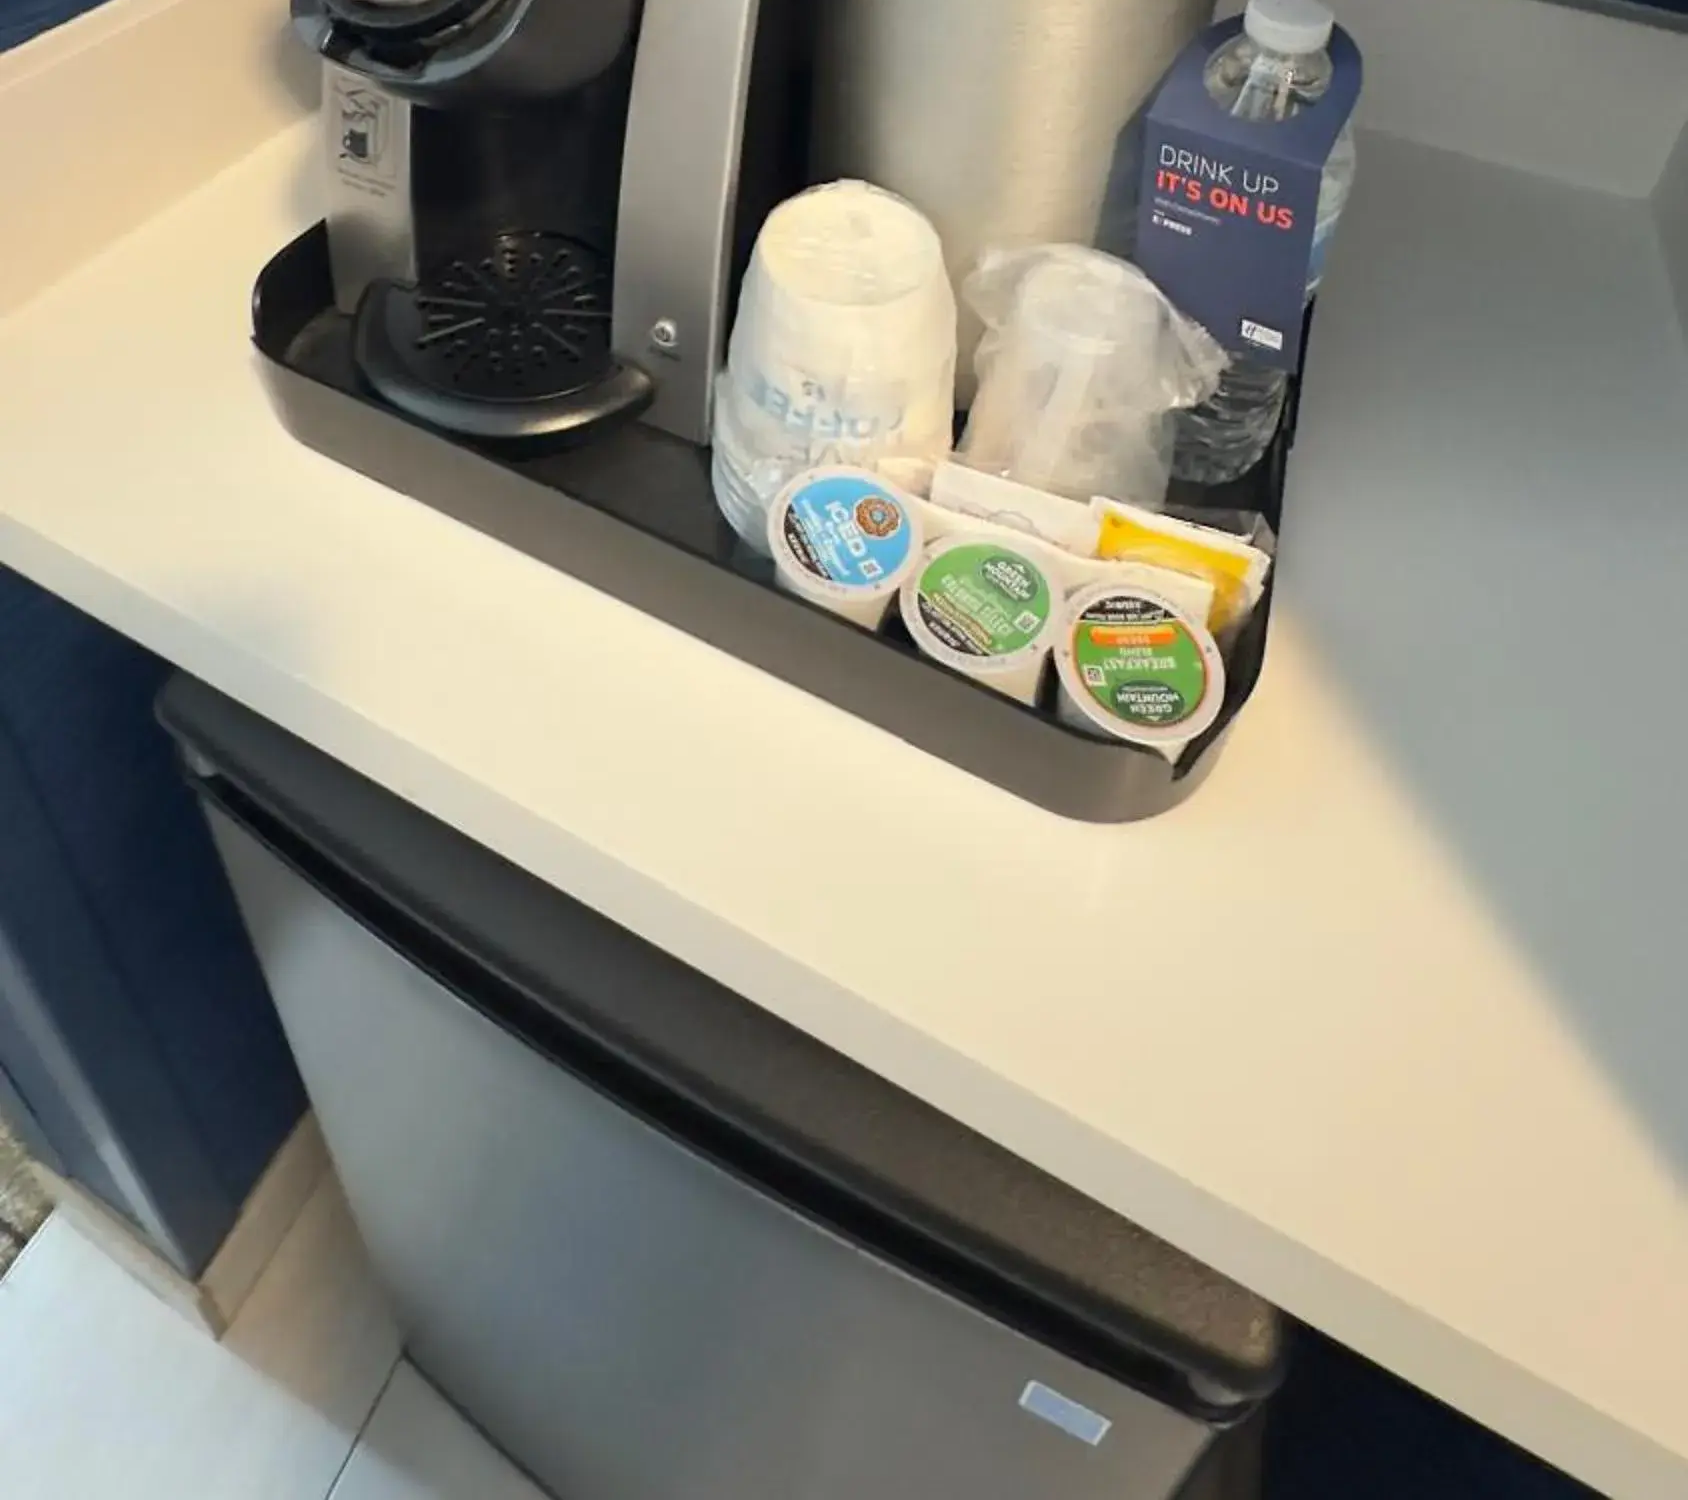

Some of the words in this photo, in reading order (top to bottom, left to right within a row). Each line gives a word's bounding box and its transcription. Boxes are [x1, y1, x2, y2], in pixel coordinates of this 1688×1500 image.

[1160, 143, 1234, 186] DRINK
[1243, 168, 1279, 195] UP
[1156, 169, 1202, 202] IT'S
[1209, 187, 1249, 216] ON
[1257, 201, 1294, 230] US
[825, 501, 867, 558] ICED
[995, 559, 1031, 588] GREEN
[1104, 656, 1177, 671] BREAKFAST
[1116, 691, 1180, 703] MOUNTAIN
[1130, 703, 1173, 714] GREEN
